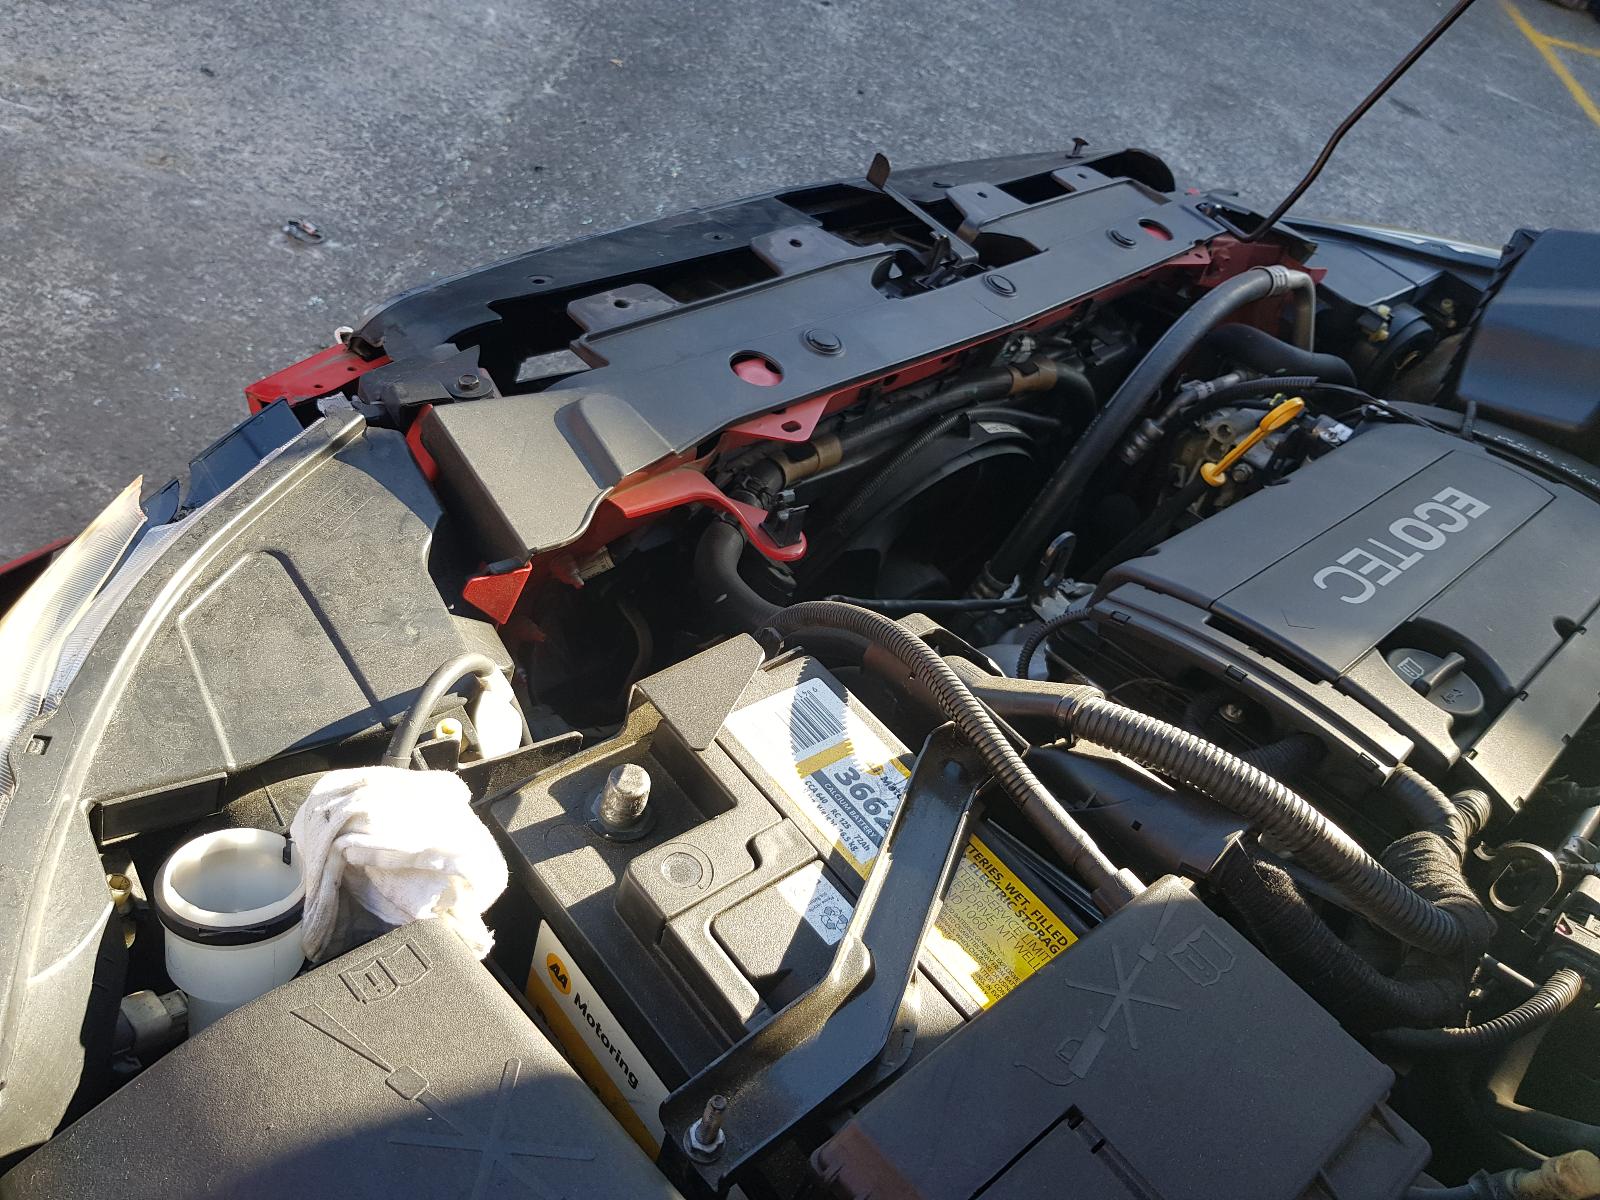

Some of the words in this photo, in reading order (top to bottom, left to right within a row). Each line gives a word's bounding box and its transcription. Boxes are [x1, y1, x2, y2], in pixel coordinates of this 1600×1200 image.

[1313, 486, 1491, 604] ECOTEC
[804, 780, 818, 794] CCA
[816, 791, 828, 804] 640
[831, 808, 842, 819] RC
[839, 817, 852, 830] 125
[854, 833, 871, 851] 72Ah
[824, 783, 852, 812] CALCIUM
[849, 810, 877, 838] BATTERY
[833, 766, 895, 831] 3662
[847, 840, 858, 852] kg
[966, 861, 1016, 910] ELECTRIC
[950, 910, 977, 937] BATTERIES
[973, 934, 999, 959] GENERATE
[960, 905, 988, 932] 1060
[965, 893, 998, 927] DRIVE,
[995, 924, 1016, 943] MT
[982, 894, 1024, 936] SERVICE
[1004, 882, 1032, 911] WET,
[1029, 909, 1069, 947] FILLED
[549, 962, 568, 989] AA
[574, 992, 639, 1090] Motoring
